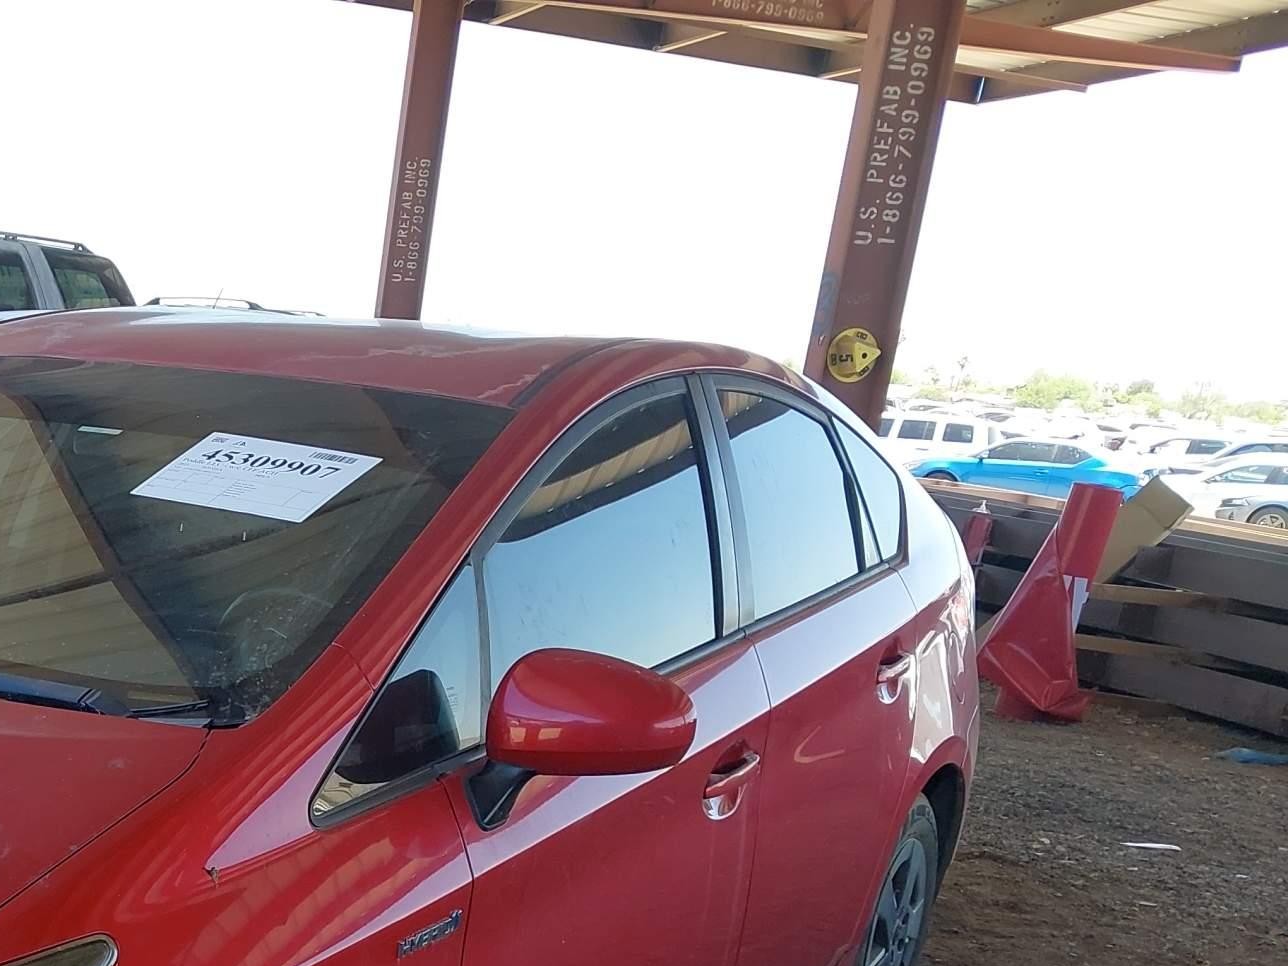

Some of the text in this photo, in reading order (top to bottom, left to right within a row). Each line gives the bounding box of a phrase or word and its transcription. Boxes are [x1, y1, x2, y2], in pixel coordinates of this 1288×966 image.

[854, 23, 914, 245] U.S. PREFAB INC.
[877, 26, 935, 244] 1-866-799-0969
[392, 157, 419, 282] U.S. PREFAB INC.
[404, 158, 432, 282] 1-866-799-0969
[201, 449, 342, 479] 45309907
